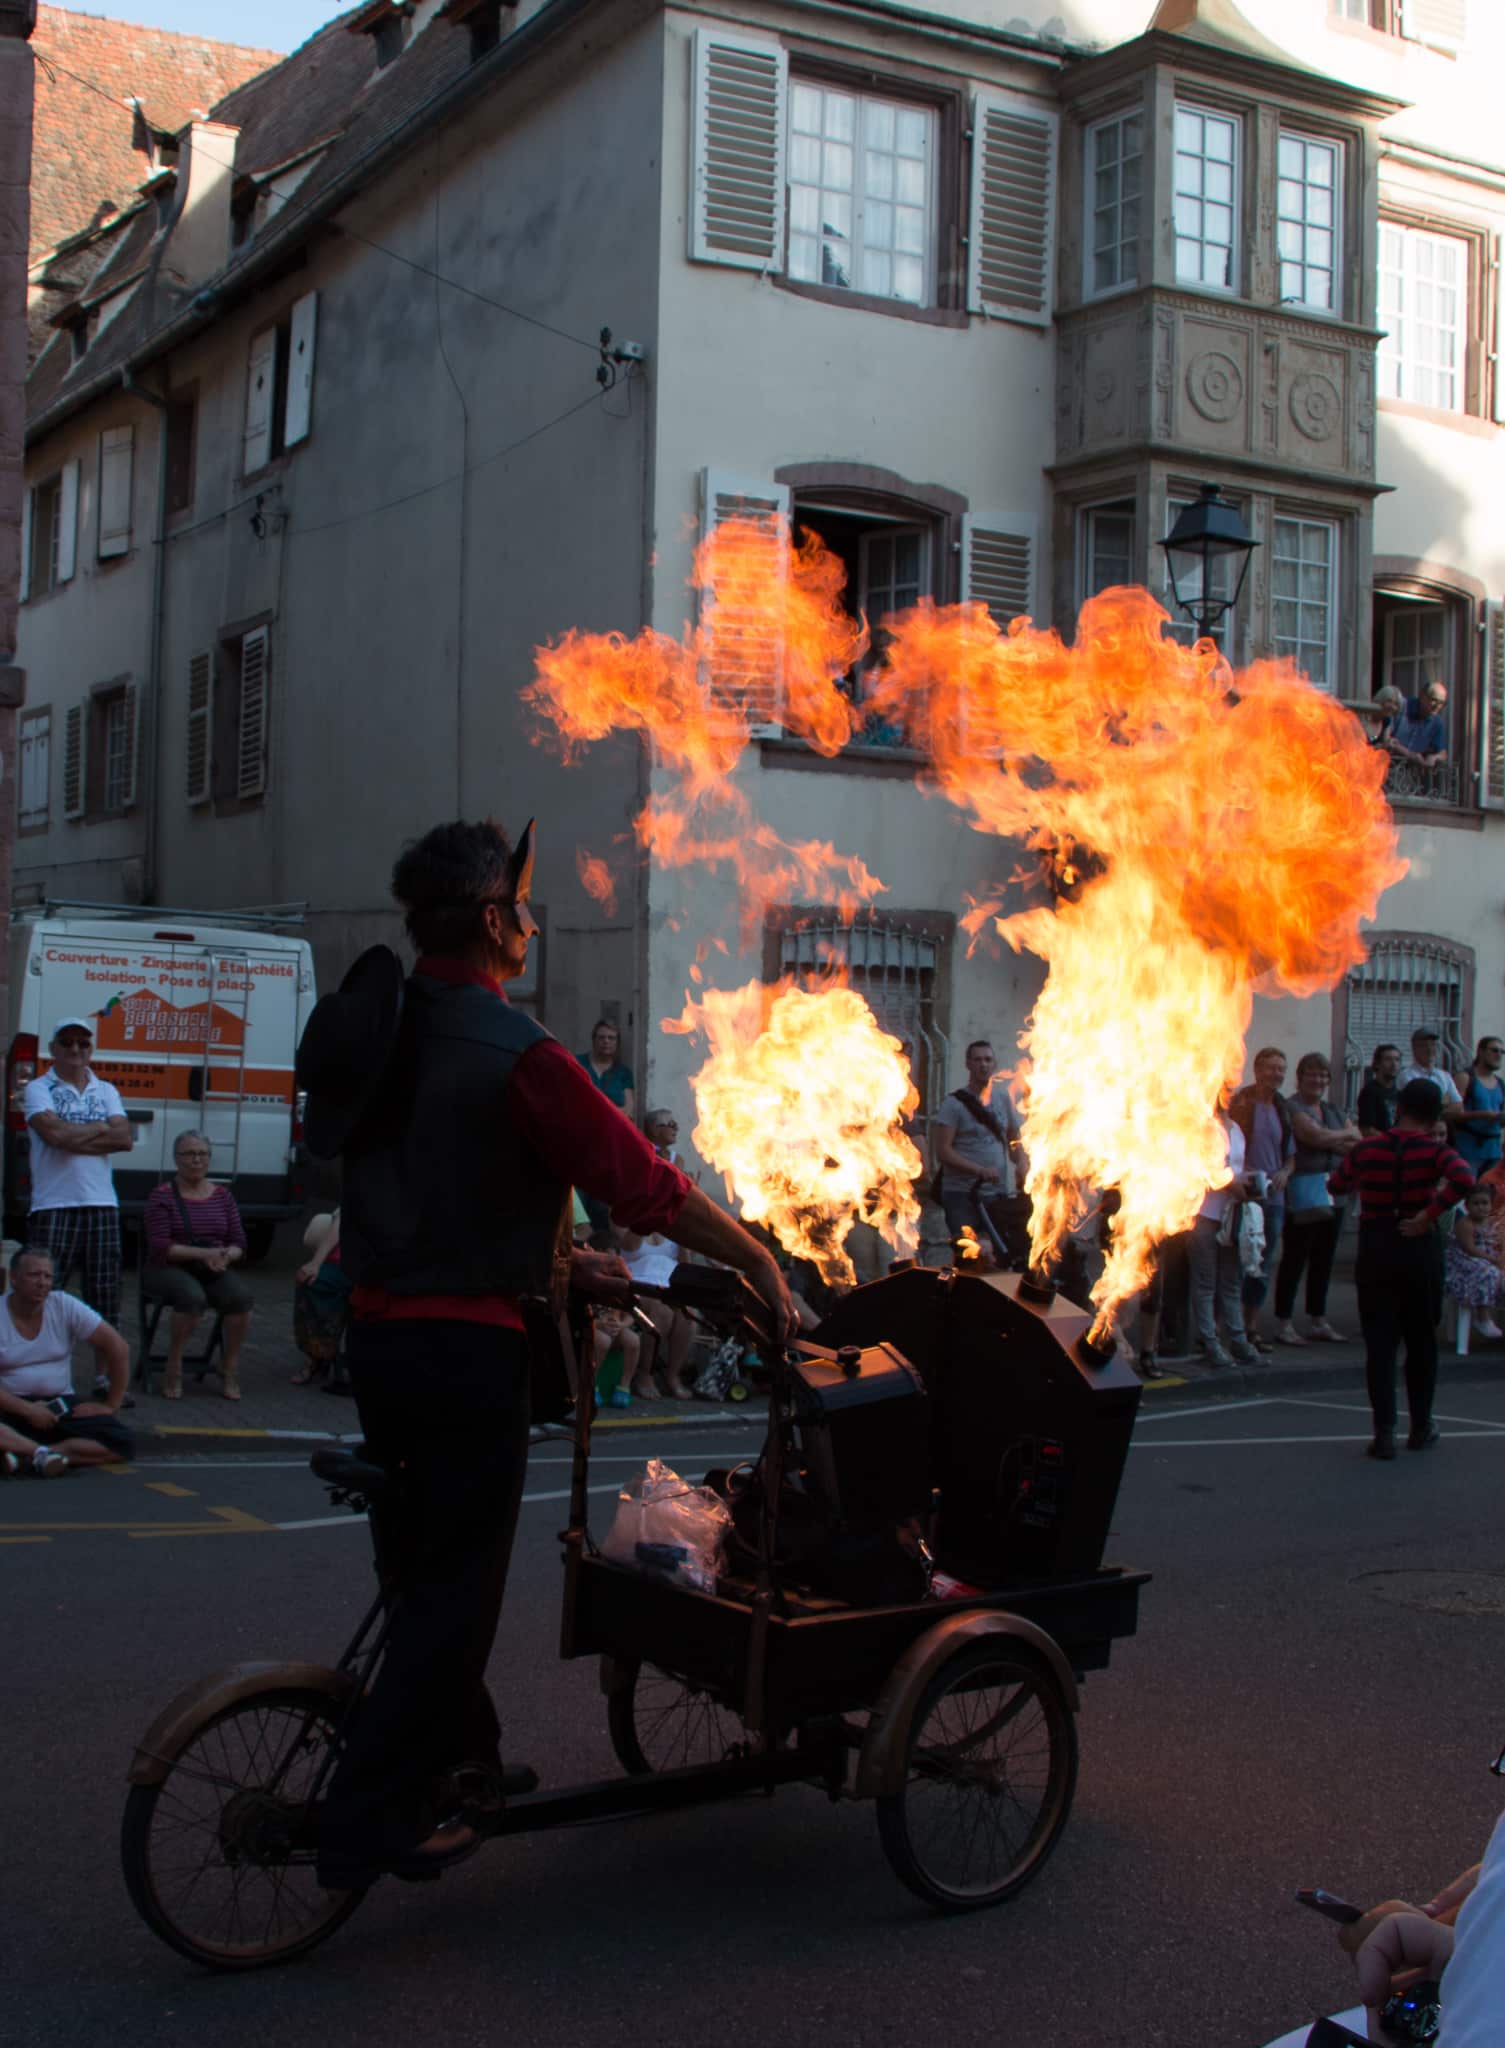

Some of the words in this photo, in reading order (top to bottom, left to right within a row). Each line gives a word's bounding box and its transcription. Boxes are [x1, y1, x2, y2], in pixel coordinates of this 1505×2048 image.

[46, 949, 129, 966] Couverture
[141, 956, 207, 971] Zinguerie
[85, 969, 146, 984] Isolation
[159, 974, 193, 987] Pose
